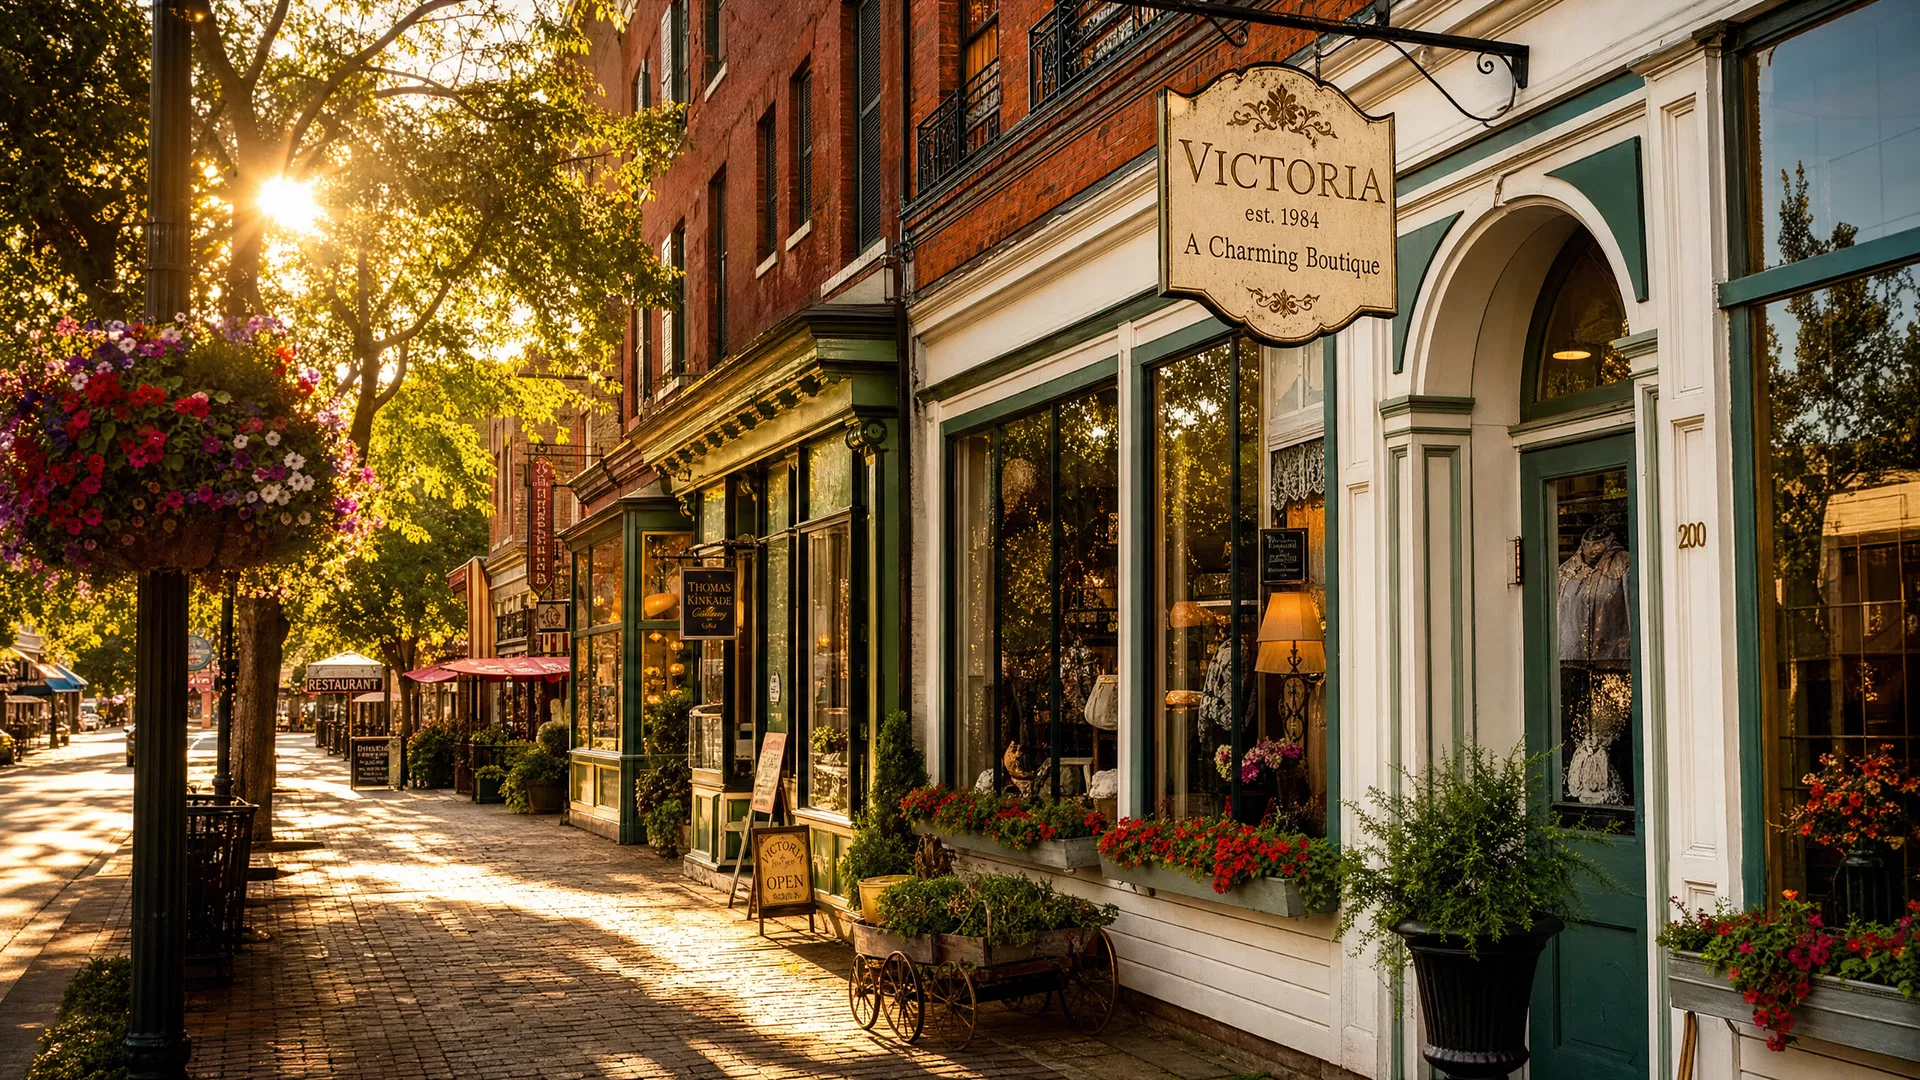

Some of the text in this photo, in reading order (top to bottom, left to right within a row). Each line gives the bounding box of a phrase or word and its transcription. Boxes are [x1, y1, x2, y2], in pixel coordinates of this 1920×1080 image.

[1178, 138, 1386, 204] VICTORIA
[1245, 207, 1320, 229] est. 1984
[1184, 233, 1381, 279] A Charming Boutique
[1678, 521, 1707, 550] 200
[687, 581, 731, 593] THOMAS
[687, 594, 732, 605] KINKADE
[308, 678, 378, 691] RESTAURANT
[761, 840, 804, 864] VICTORIA
[766, 874, 804, 890] OPEN
